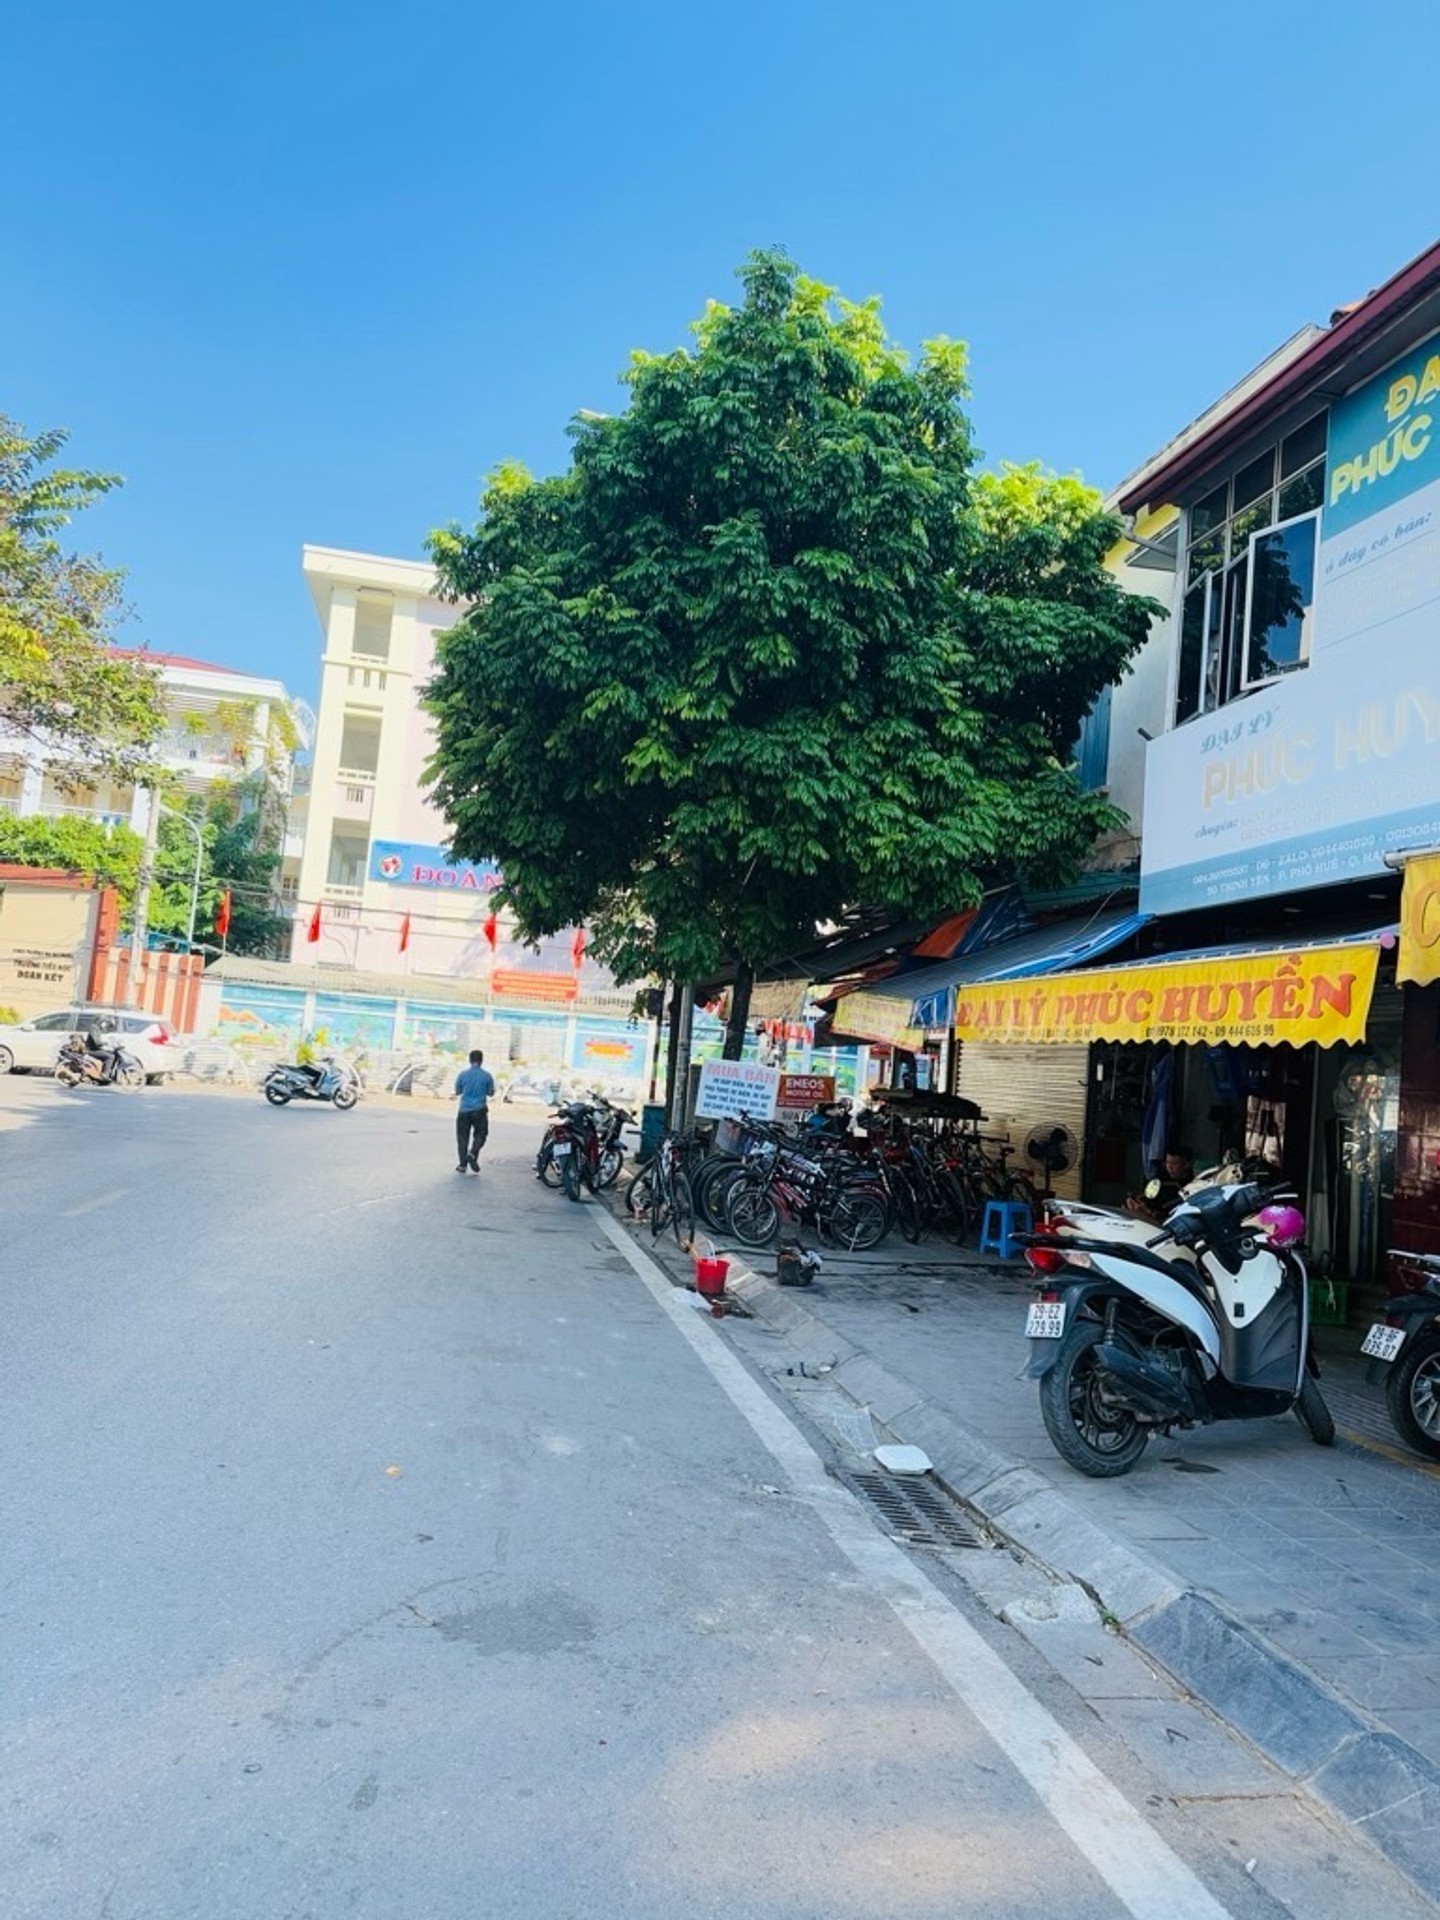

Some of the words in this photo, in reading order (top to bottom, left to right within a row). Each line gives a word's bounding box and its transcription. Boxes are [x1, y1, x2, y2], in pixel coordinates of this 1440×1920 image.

[1329, 414, 1433, 507] PHÚC
[1202, 716, 1317, 811] PHÚC
[1008, 988, 1046, 1027] LÝ
[1055, 982, 1153, 1026] PHÚC
[1158, 953, 1356, 1023] HUYỀN
[785, 1078, 825, 1091] ENEOS
[786, 1090, 811, 1098] MOTOR
